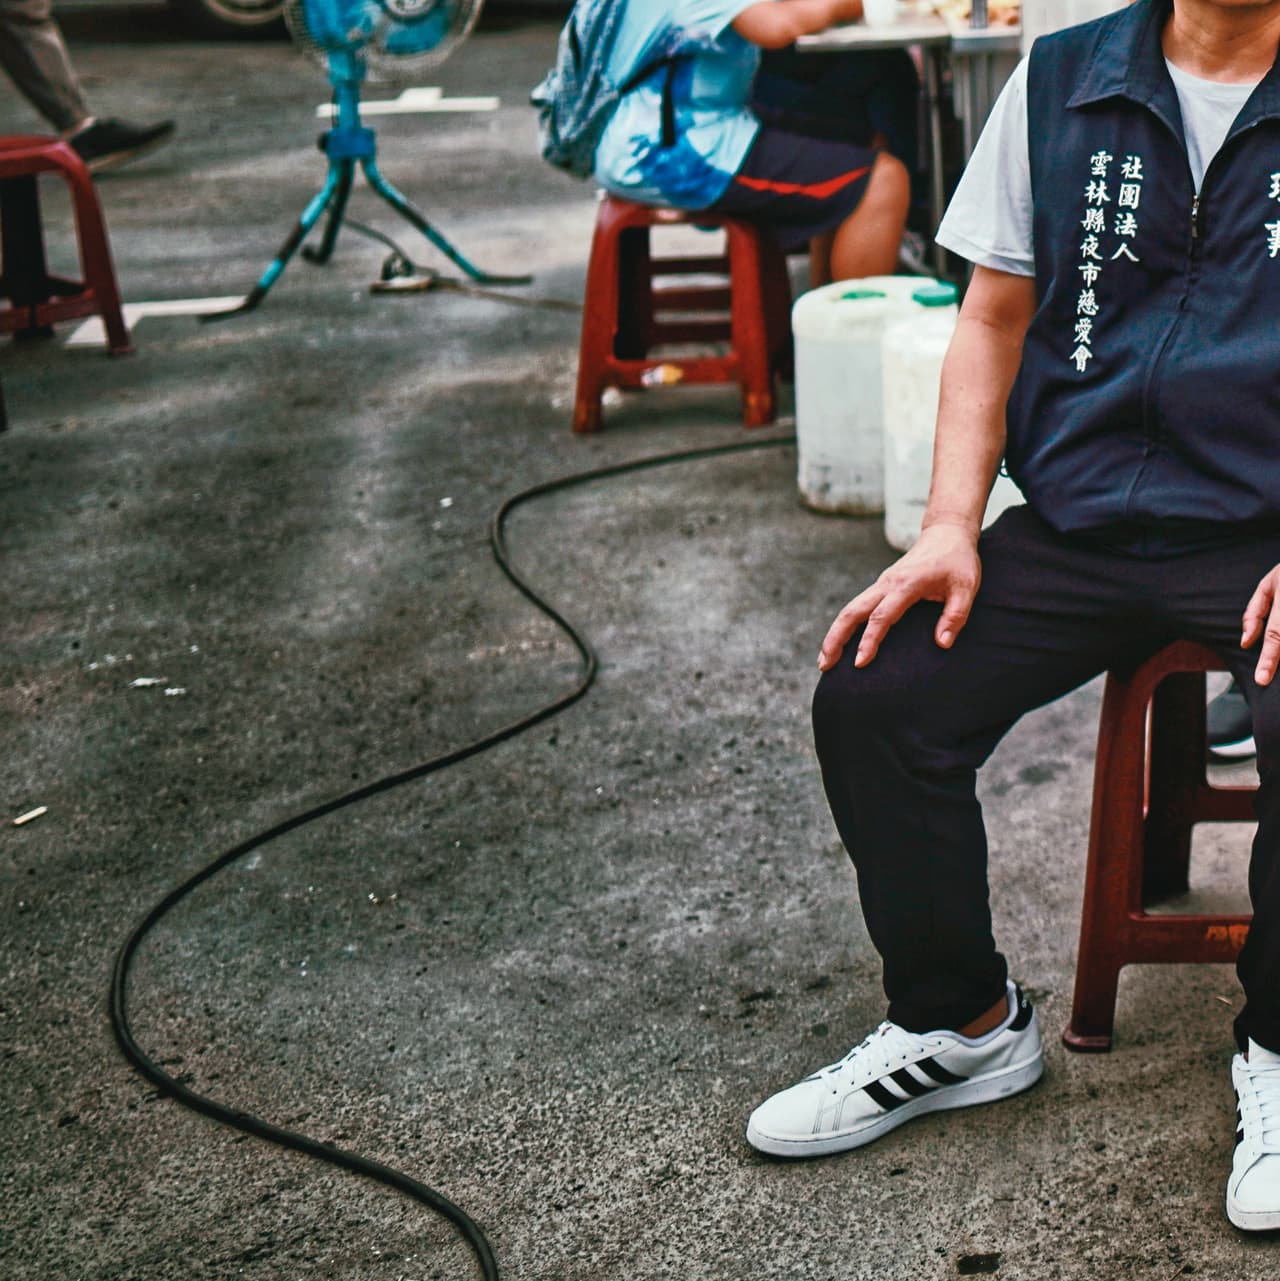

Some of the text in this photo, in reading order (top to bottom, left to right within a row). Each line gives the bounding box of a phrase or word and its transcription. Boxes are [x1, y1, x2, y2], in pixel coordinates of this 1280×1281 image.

[1069, 150, 1114, 373] 雲林縣夜市慈愛會
[1110, 155, 1144, 263] 社團法人
